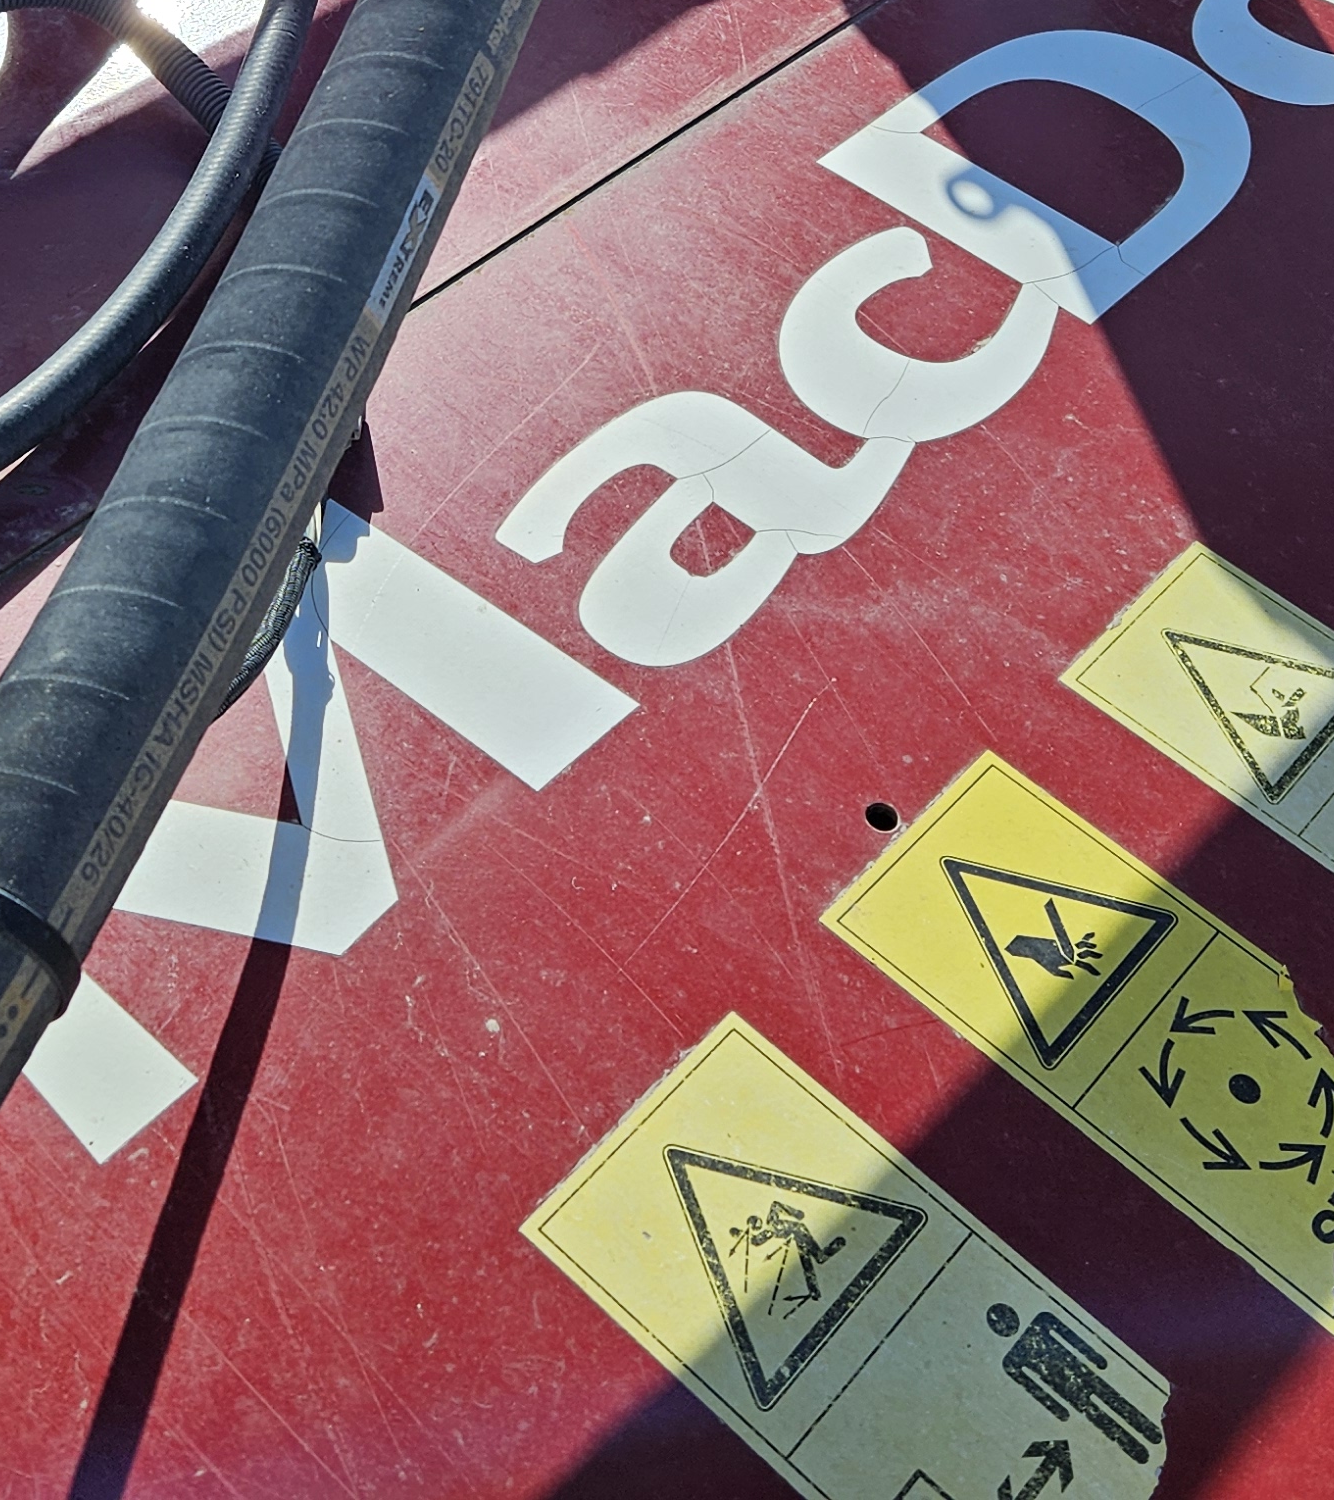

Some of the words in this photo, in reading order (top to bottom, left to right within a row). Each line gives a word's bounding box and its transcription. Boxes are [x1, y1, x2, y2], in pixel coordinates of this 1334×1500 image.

[431, 66, 490, 174] 791TC-20
[378, 188, 435, 307] EXTREME
[338, 334, 370, 381] WP
[279, 439, 320, 504] MPa
[237, 506, 289, 586] (6000
[204, 585, 247, 652] PSI)
[154, 650, 214, 749] MSHA
[79, 750, 161, 885] IC-40/26
